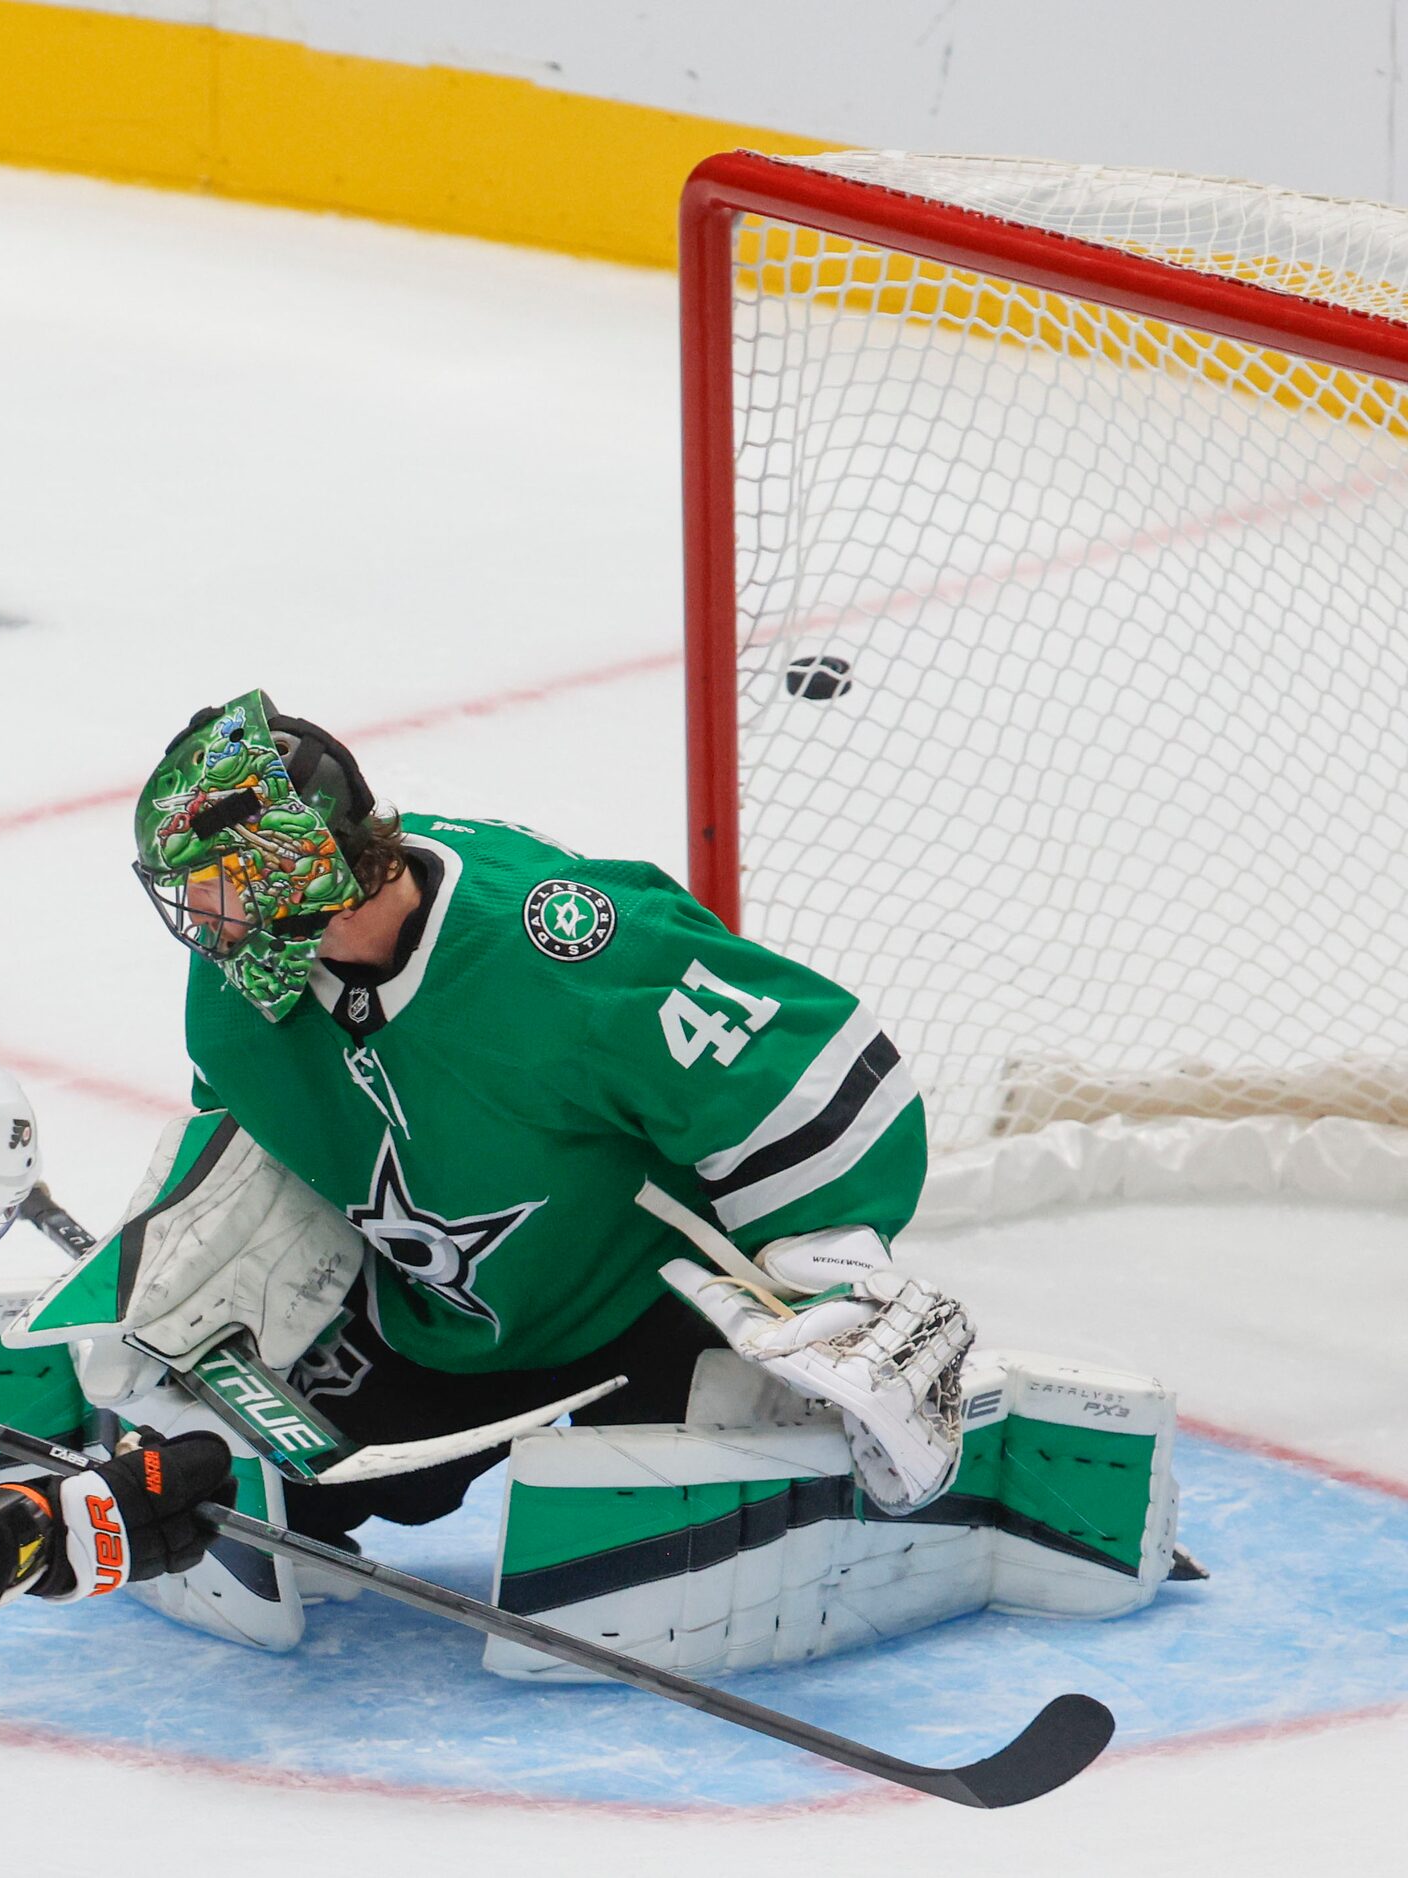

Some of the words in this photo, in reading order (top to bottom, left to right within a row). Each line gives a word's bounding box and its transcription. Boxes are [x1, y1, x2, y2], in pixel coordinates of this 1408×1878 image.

[530, 883, 579, 945] DALLAS
[567, 898, 610, 955] STARS
[658, 958, 782, 1069] 41
[201, 1349, 326, 1451] TRUE
[1029, 1382, 1126, 1404] CATALYST
[1083, 1401, 1131, 1419] PX3
